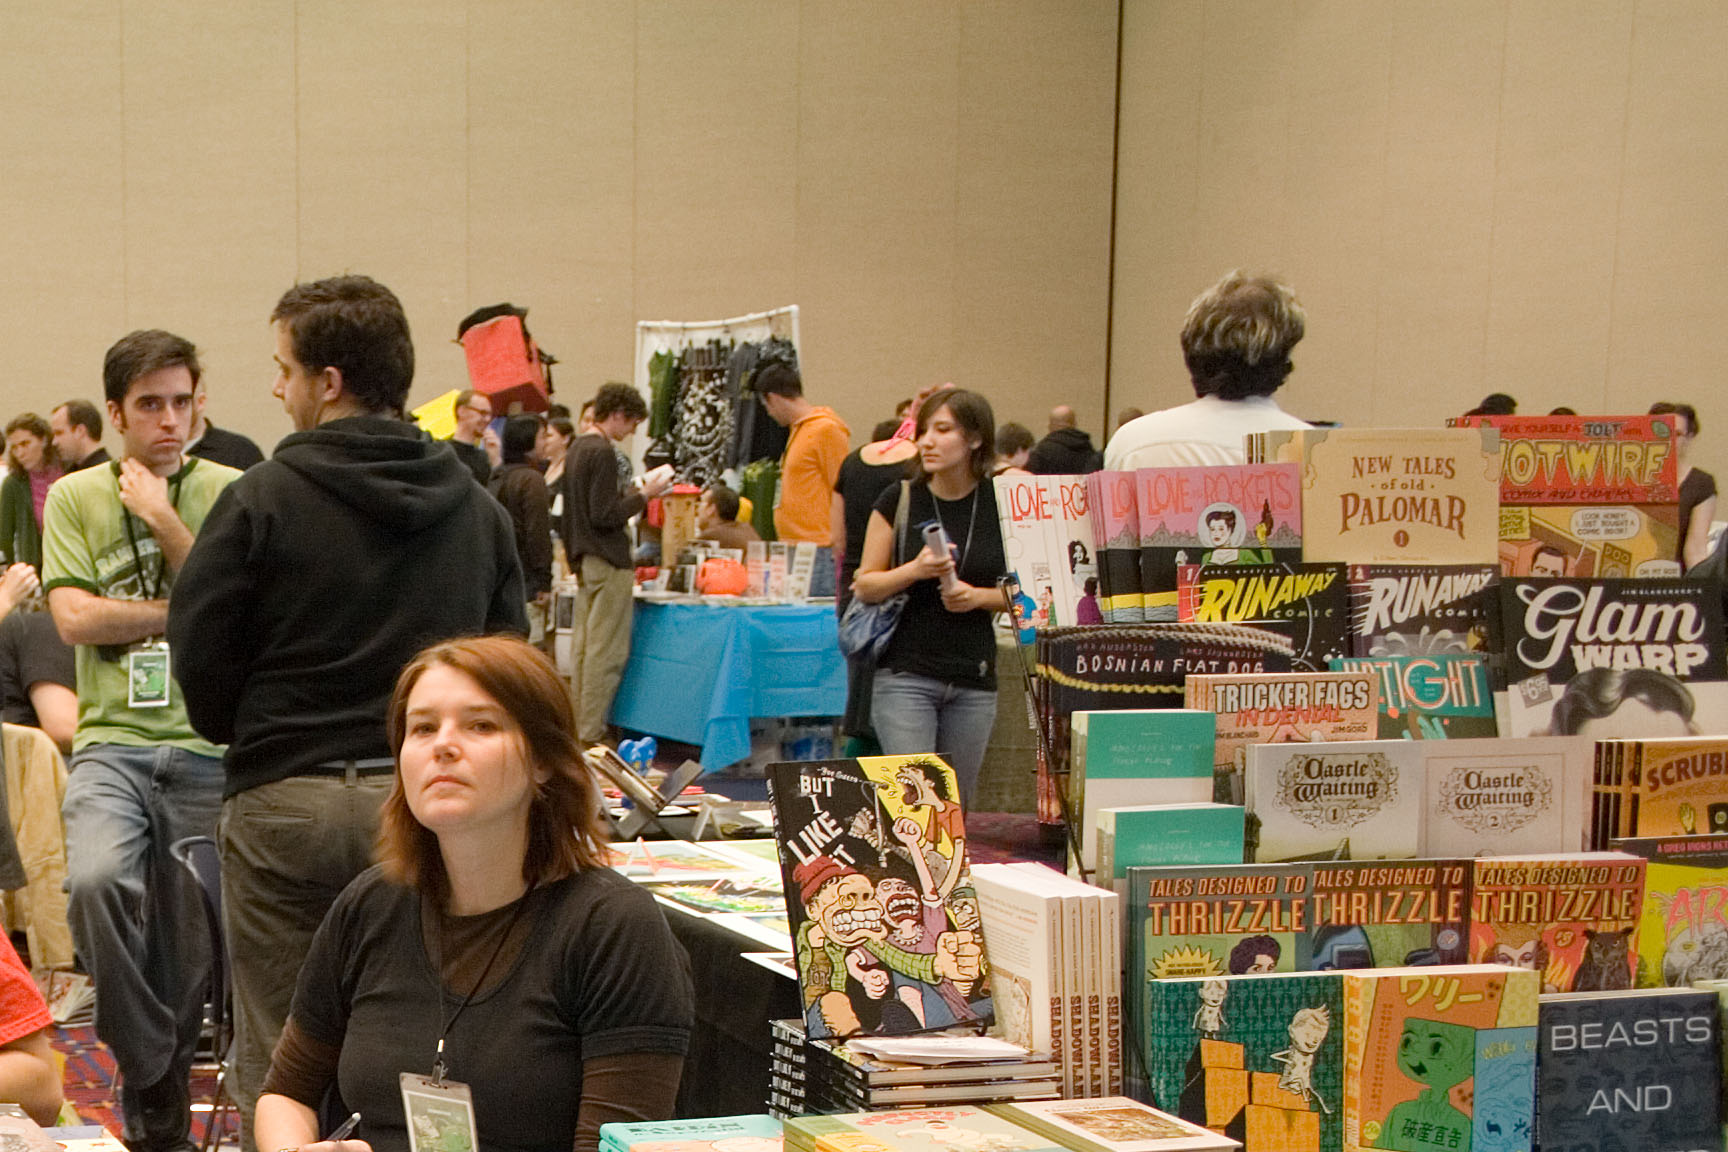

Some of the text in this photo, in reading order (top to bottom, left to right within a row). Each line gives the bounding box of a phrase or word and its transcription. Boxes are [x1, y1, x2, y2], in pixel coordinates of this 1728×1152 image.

[1352, 455, 1456, 479] NEW TALES
[1009, 482, 1052, 521] LOVE
[1147, 471, 1193, 516] LOVE
[1380, 479, 1424, 491] of old
[1339, 492, 1467, 541] PALOMAR
[1186, 567, 1194, 581] 1
[1195, 572, 1337, 622] RUNAWAY
[1273, 608, 1334, 619] COMIC
[1359, 572, 1494, 637] RUNAWAY
[1515, 583, 1706, 669] Glam
[1172, 658, 1220, 673] FLAT
[1227, 661, 1264, 674] DOG
[1569, 643, 1710, 676] WARP
[1213, 680, 1370, 714] TRUCKER FAGS
[1235, 704, 1345, 727] IN DENIAL
[799, 774, 835, 798] BUT
[809, 794, 823, 814] I
[786, 811, 844, 866] LIKE
[1149, 875, 1306, 897] TALES DESIGNED TO
[1312, 866, 1464, 889] TALES DESIGNED TO
[1477, 865, 1640, 887] TALES DESIGNED TO
[1148, 898, 1308, 937] THRIZZLE
[1312, 890, 1464, 926] THRIZZLE
[1475, 888, 1640, 925] THRIZZLE
[1070, 995, 1084, 1099] SHADOWLAN
[1088, 994, 1102, 1098] SHADOWLAN
[1551, 1016, 1711, 1051] BEASTS
[1586, 1085, 1672, 1115] AND
